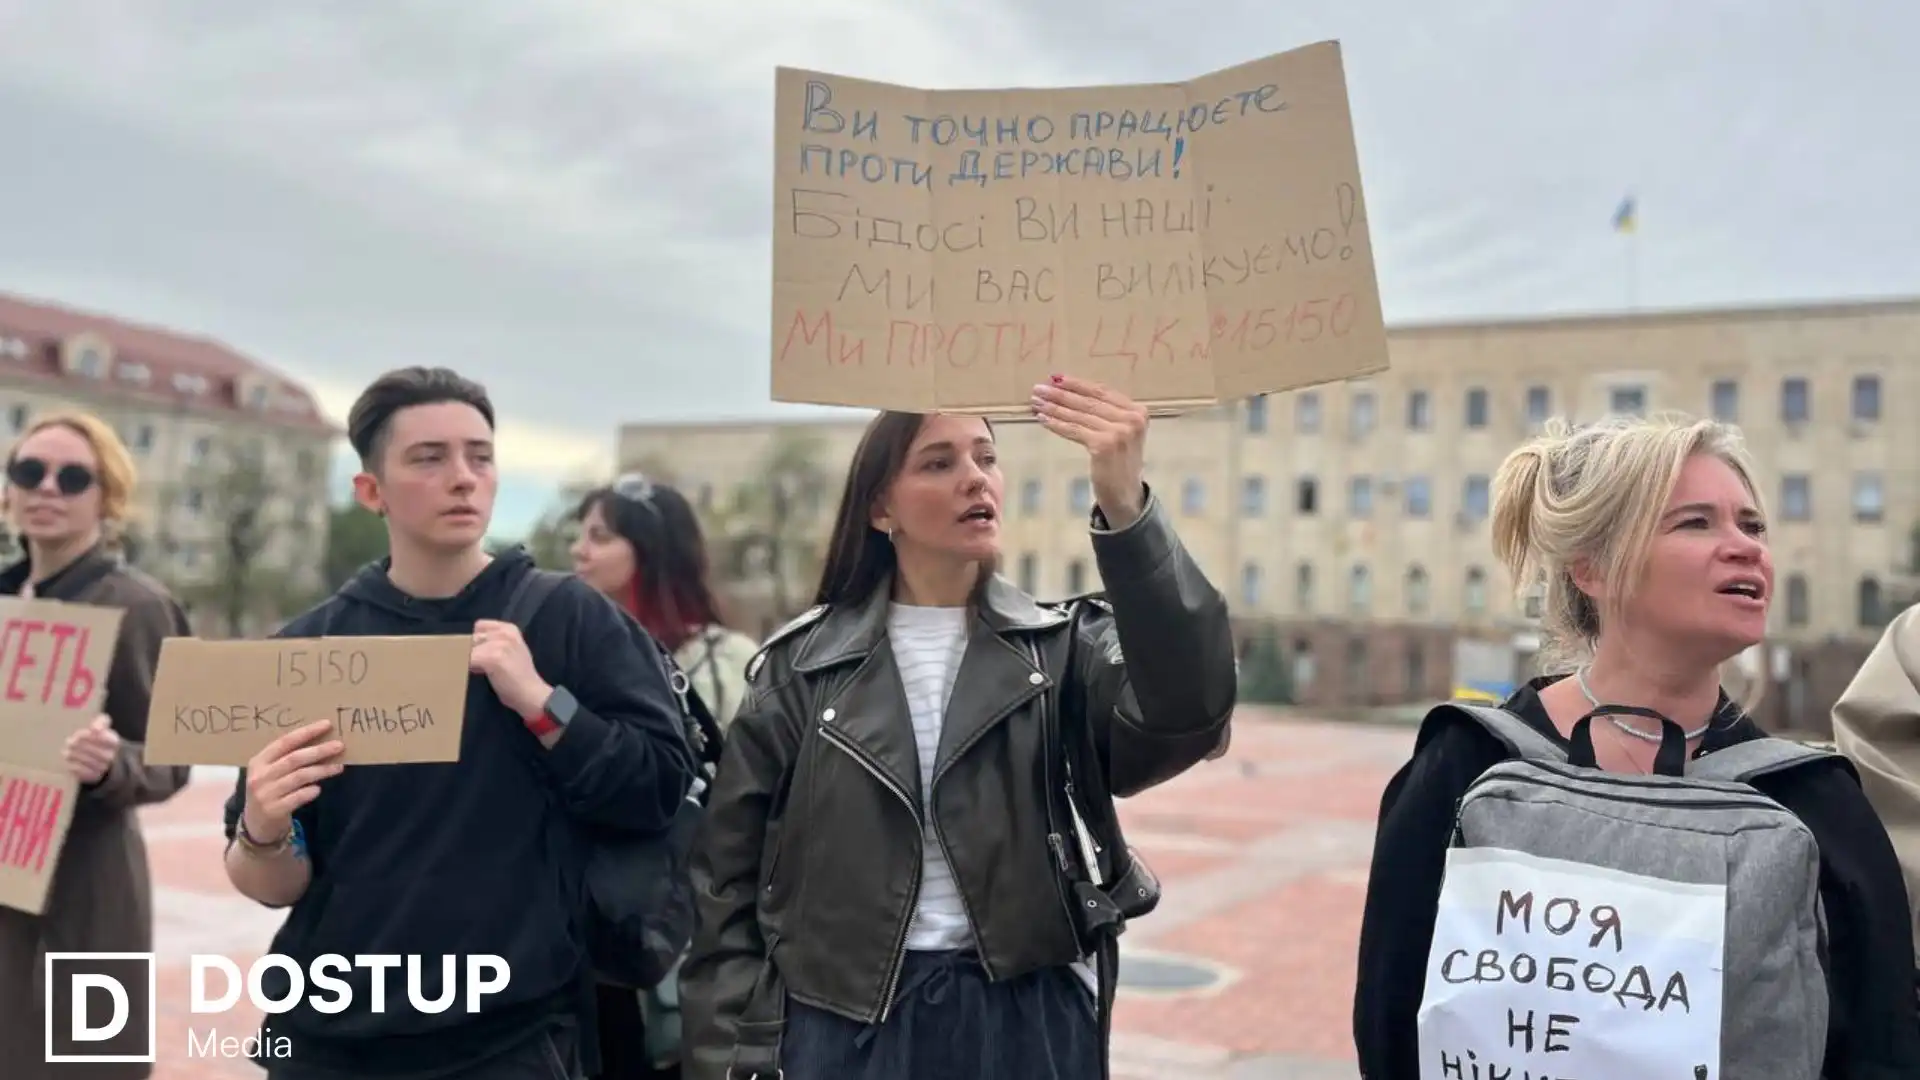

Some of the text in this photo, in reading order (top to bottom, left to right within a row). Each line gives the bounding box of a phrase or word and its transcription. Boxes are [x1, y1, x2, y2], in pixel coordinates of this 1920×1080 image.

[802, 81, 878, 143] Ви
[902, 113, 1055, 147] ТОЧНО
[800, 136, 1185, 192] ПРОТИ ДЕРЖАВИ!
[1015, 196, 1080, 244] ВИ
[975, 267, 1056, 303] ВАС
[886, 318, 1056, 370] ПРОТИ
[1089, 313, 1180, 372] ЦК
[275, 650, 370, 687] 15150
[336, 703, 435, 737] ГАНЬБИ
[1496, 889, 1623, 953] МОЯ
[1440, 948, 1691, 1014] СВОБОДА
[1507, 1007, 1580, 1053] НЕ
